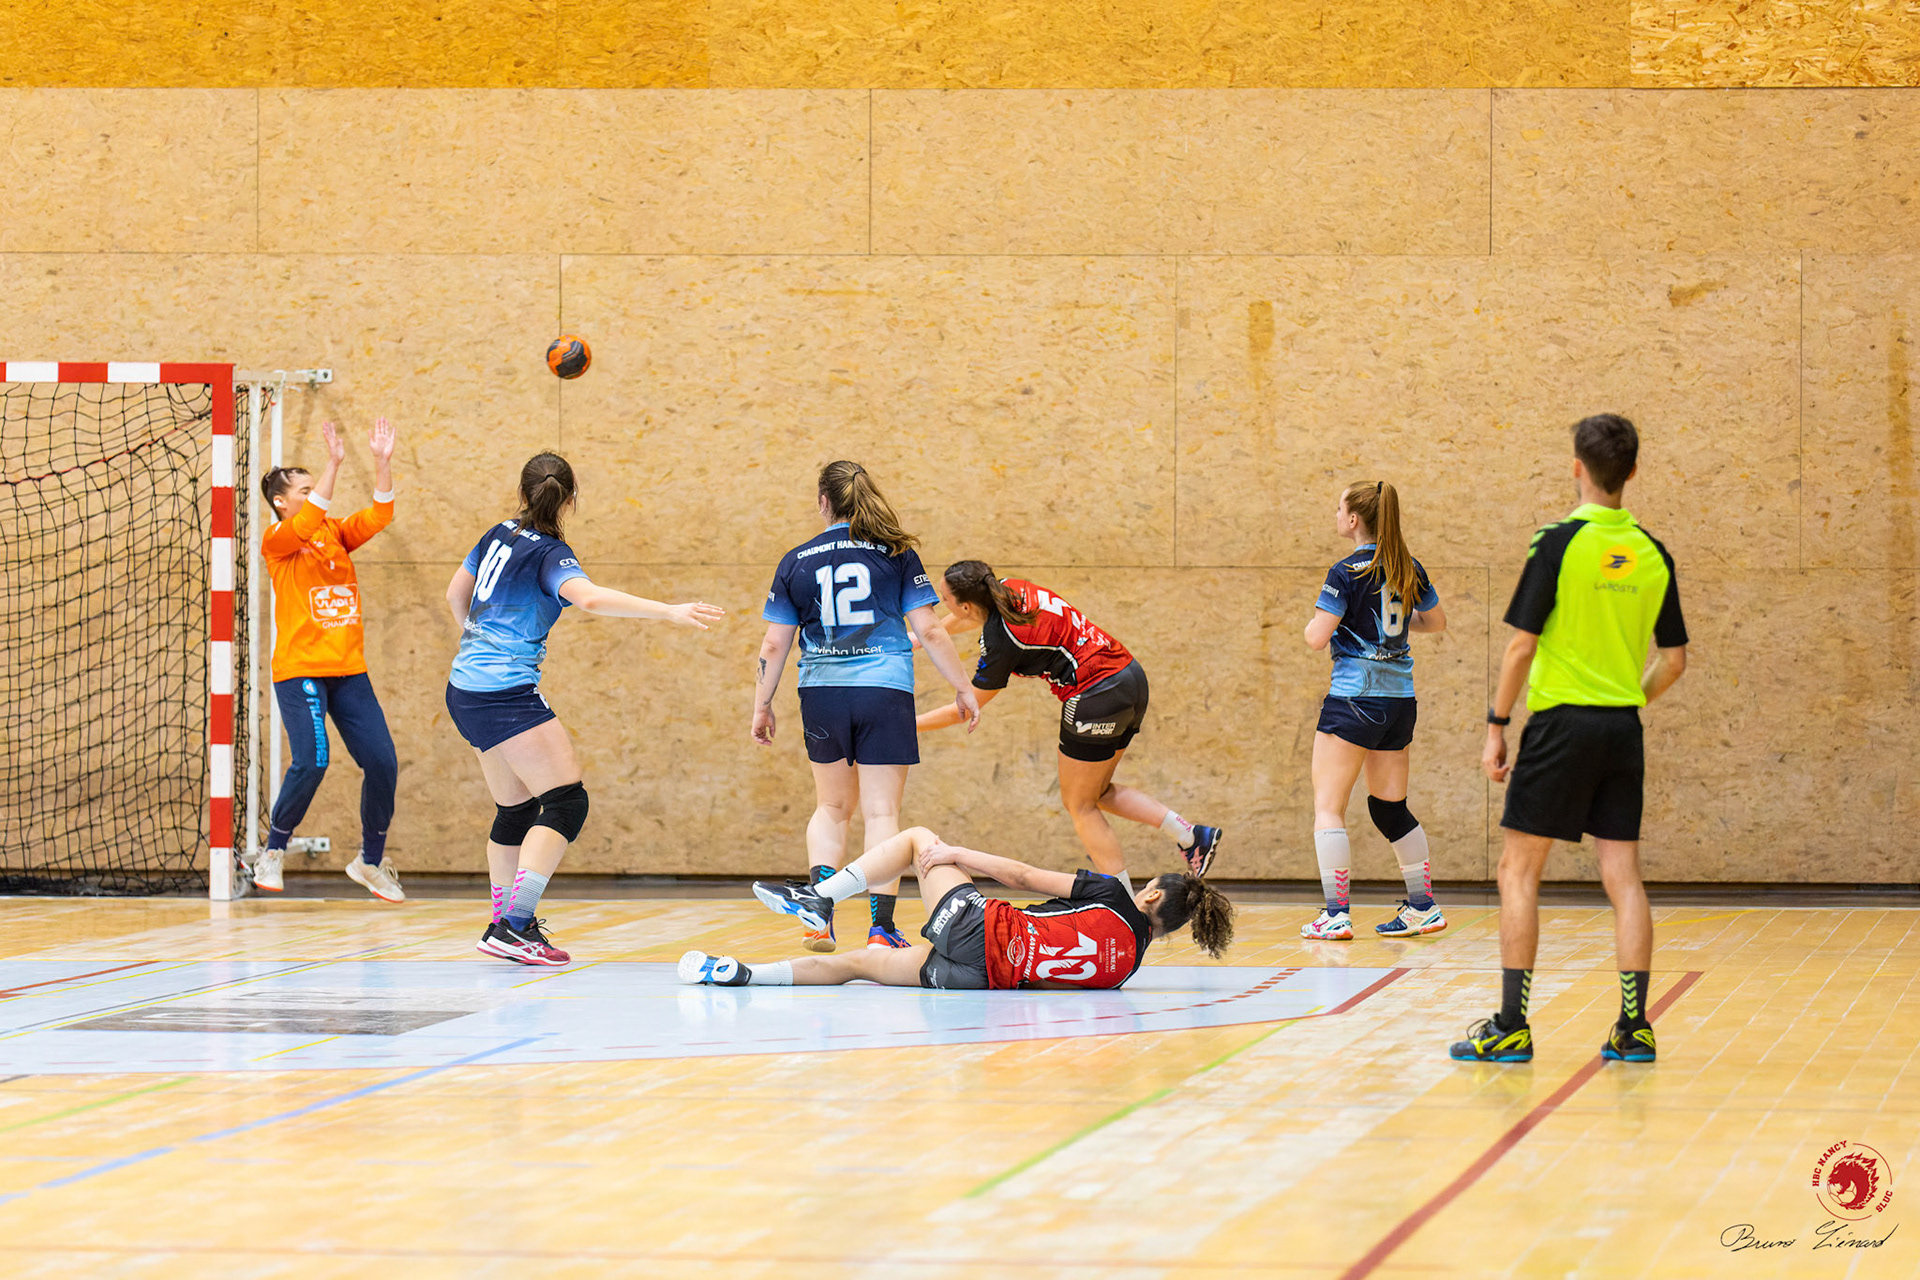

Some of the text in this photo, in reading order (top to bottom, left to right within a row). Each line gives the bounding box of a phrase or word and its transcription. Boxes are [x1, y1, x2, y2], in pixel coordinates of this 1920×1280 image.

[472, 538, 513, 602] 10
[797, 541, 836, 560] CHAUMONT
[815, 562, 876, 627] 12
[1037, 589, 1081, 630] 5
[1381, 580, 1405, 637] 6
[1091, 722, 1116, 730] INTER
[1036, 931, 1098, 980] 10
